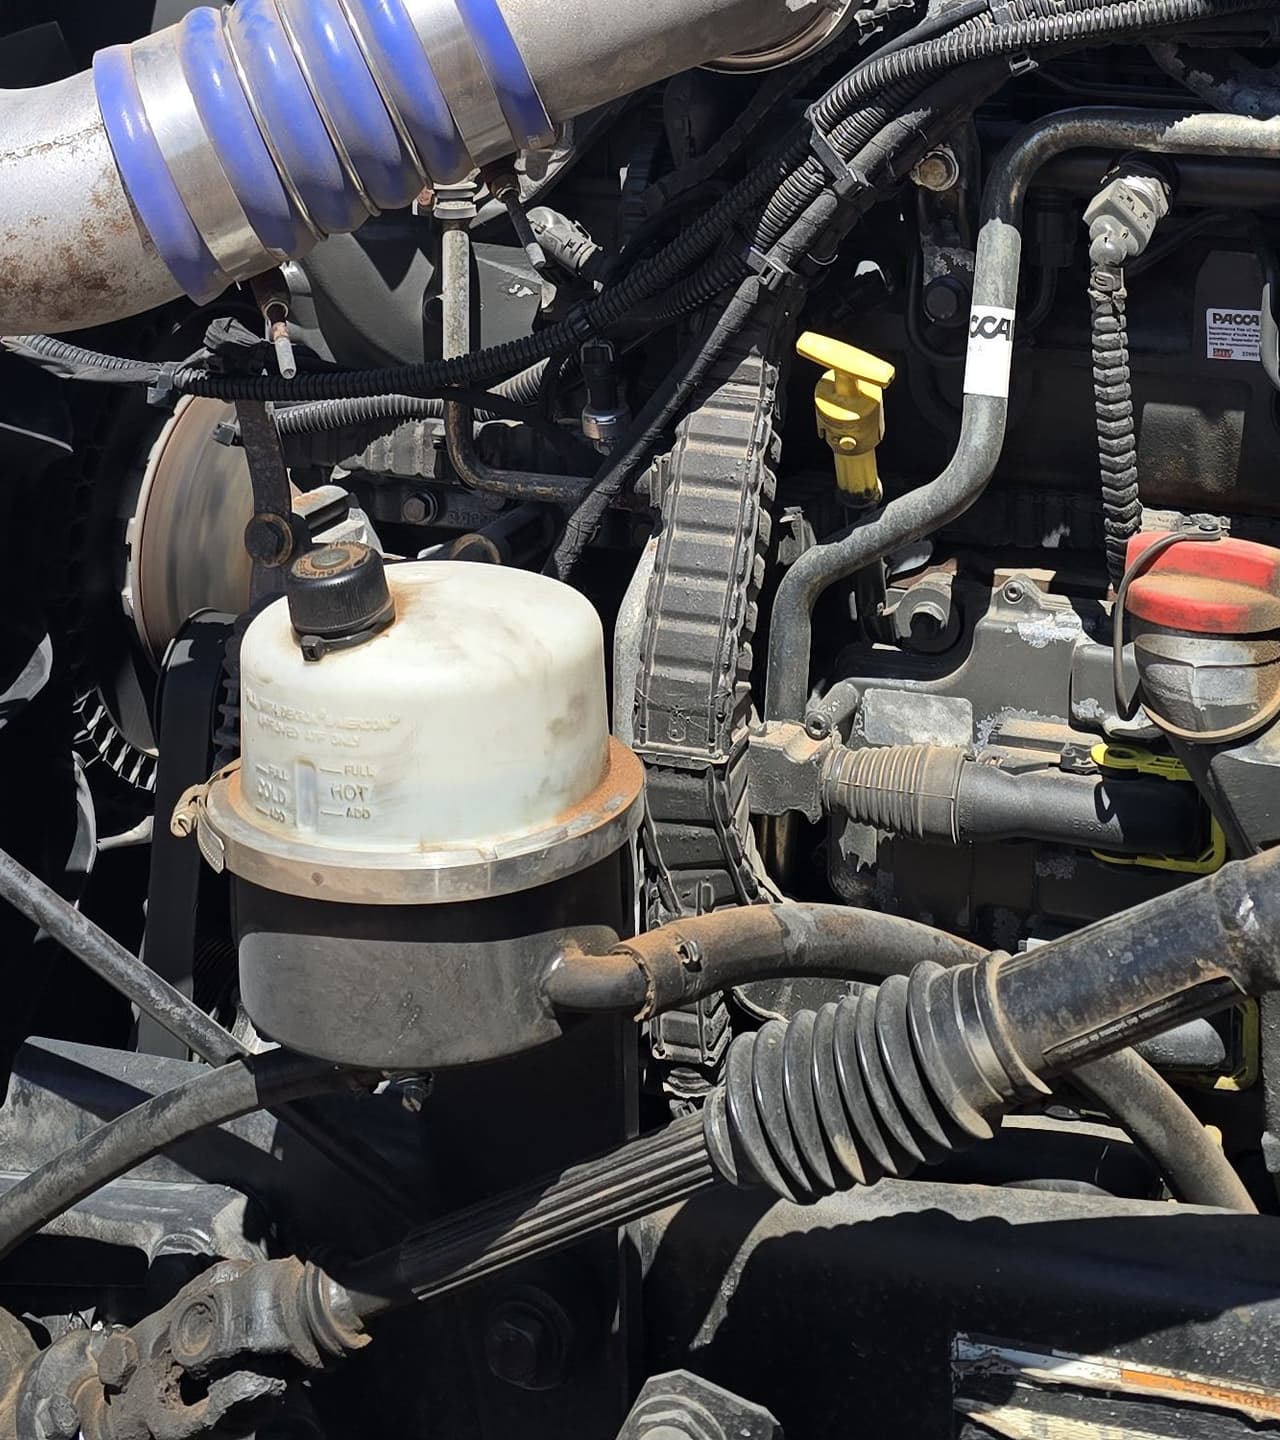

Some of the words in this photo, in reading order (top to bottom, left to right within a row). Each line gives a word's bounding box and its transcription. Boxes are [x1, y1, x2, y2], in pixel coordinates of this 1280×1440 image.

[1213, 313, 1260, 326] PACCA
[344, 764, 375, 778] FULL
[257, 778, 287, 805] COLD
[331, 782, 370, 802] HOT
[346, 806, 371, 820] ADD
